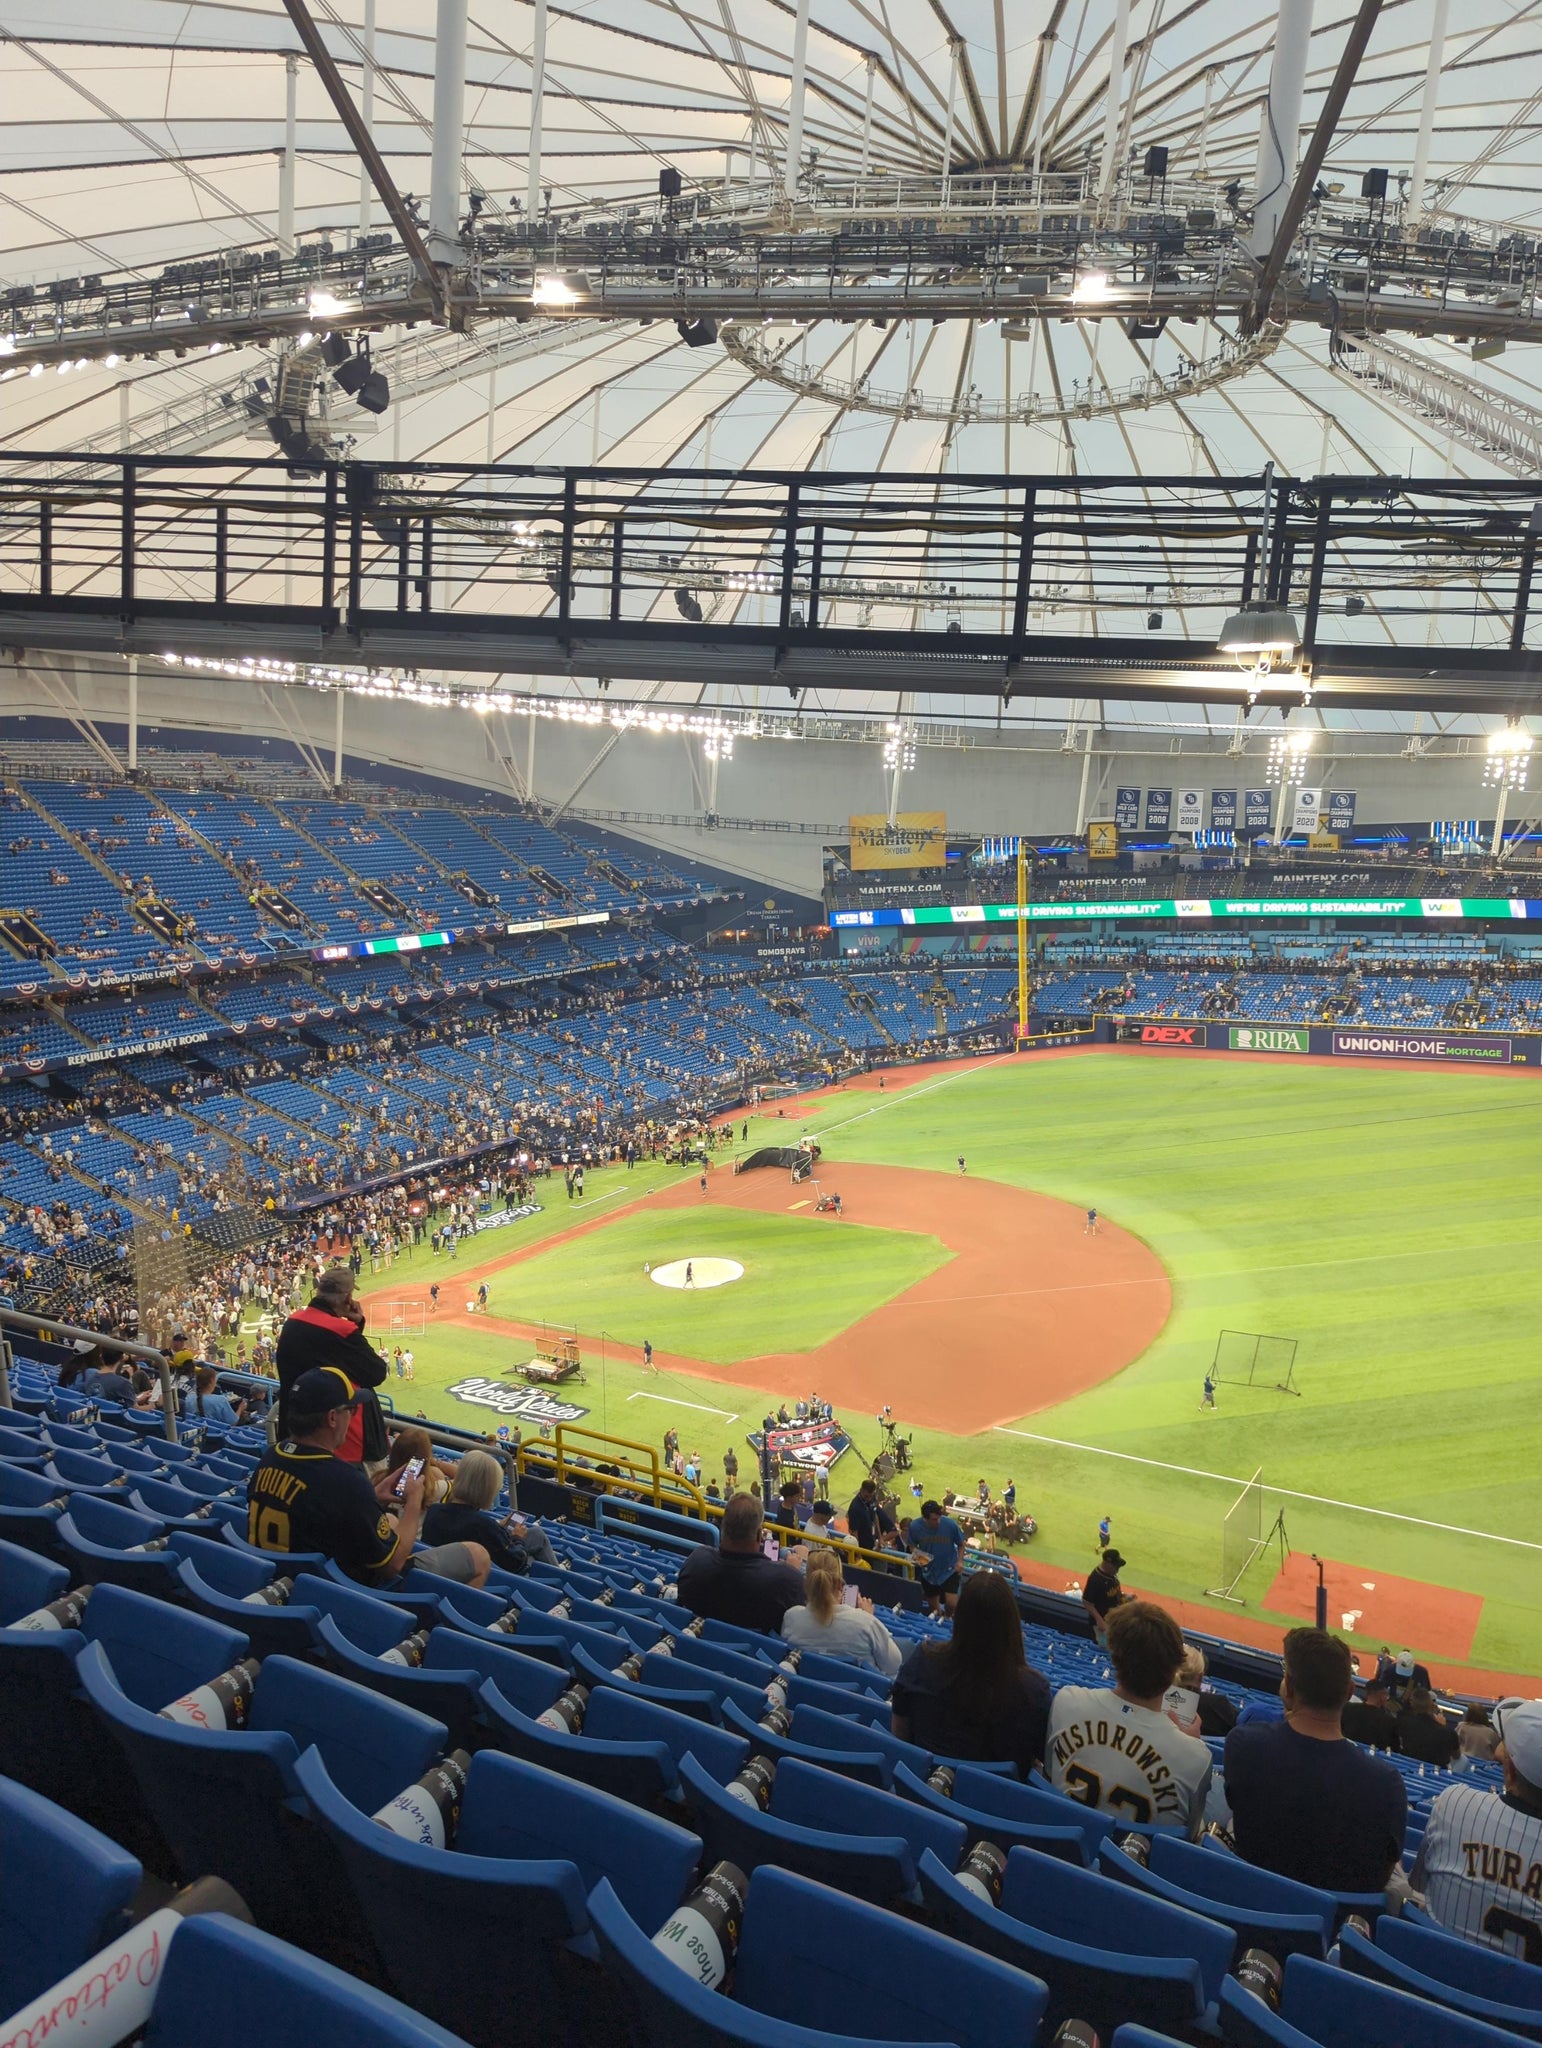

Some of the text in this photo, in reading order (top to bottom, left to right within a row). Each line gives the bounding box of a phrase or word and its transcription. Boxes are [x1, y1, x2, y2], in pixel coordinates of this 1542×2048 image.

[1248, 816, 1268, 825] 2020
[1331, 818, 1350, 828] 2021
[859, 883, 942, 895] MAINTENX.COM
[1058, 877, 1147, 887] MAINTENX.COM
[1032, 905, 1076, 916] DRIVING
[1226, 903, 1260, 913] WE'RE
[1262, 903, 1308, 913] DRIVING
[757, 948, 785, 956] SOMOS
[101, 967, 177, 986] Webull Suite Level
[1140, 1026, 1196, 1044] DEX
[1253, 1030, 1302, 1050] RIPA
[67, 1032, 209, 1066] REPUBLIC BANK DRAFT ROOM
[1446, 1047, 1503, 1058] MORTGAGE
[450, 1378, 585, 1420] World Series
[255, 1466, 308, 1506] YOUNT
[1053, 1719, 1180, 1814] MISIOROWSKI
[701, 1885, 732, 1914] TOGETHER
[1238, 1967, 1267, 1984] TOGETHER
